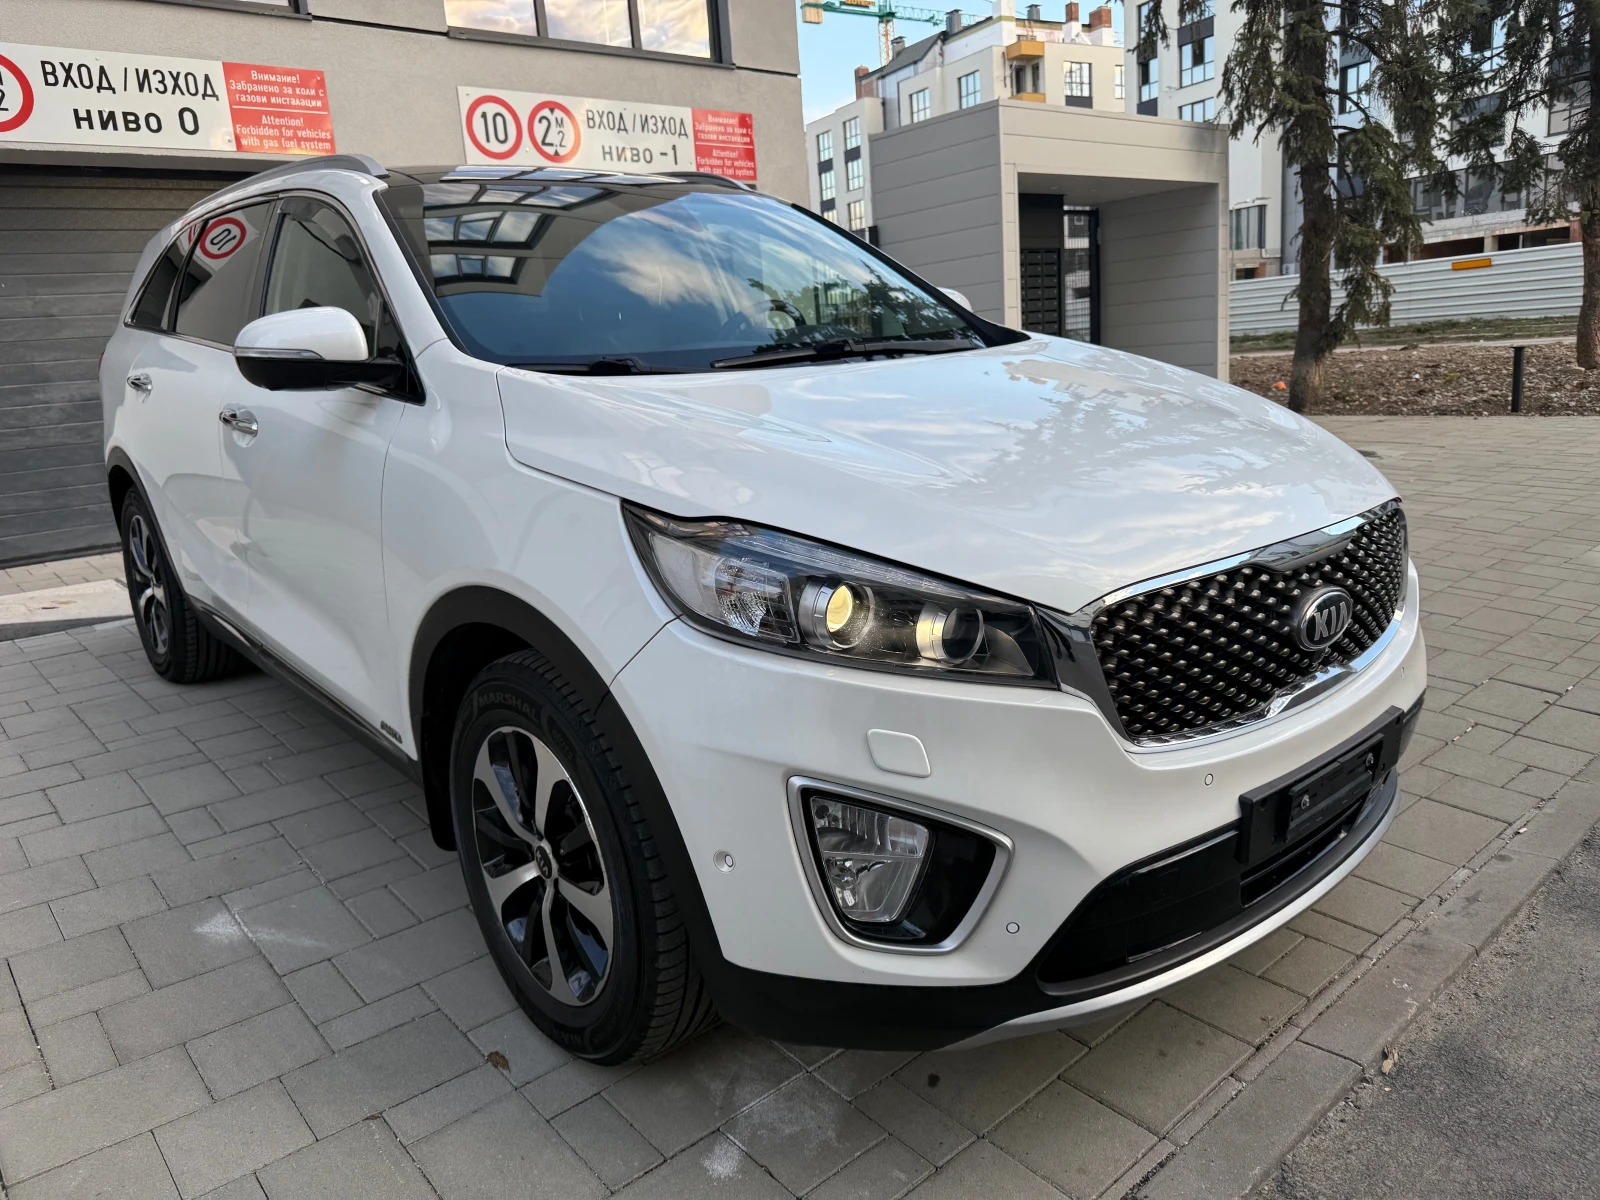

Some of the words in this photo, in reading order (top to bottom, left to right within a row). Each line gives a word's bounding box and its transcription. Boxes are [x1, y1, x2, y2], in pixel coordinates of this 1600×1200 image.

[251, 70, 300, 84] Внимание!
[229, 80, 279, 93] Забранено
[282, 86, 293, 94] за
[296, 87, 316, 96] коли
[235, 93, 267, 103] газови
[270, 96, 322, 107] инсталации
[261, 114, 304, 127] Attention!
[480, 111, 509, 144] 10
[236, 124, 279, 137] Forbidden
[282, 127, 294, 137] for
[296, 129, 332, 139] vehicles
[240, 136, 260, 146] with
[263, 139, 278, 149] gas
[281, 138, 298, 148] fuel
[300, 140, 331, 150] system
[1313, 601, 1349, 641] KIA
[478, 692, 540, 723] MARSHAL
